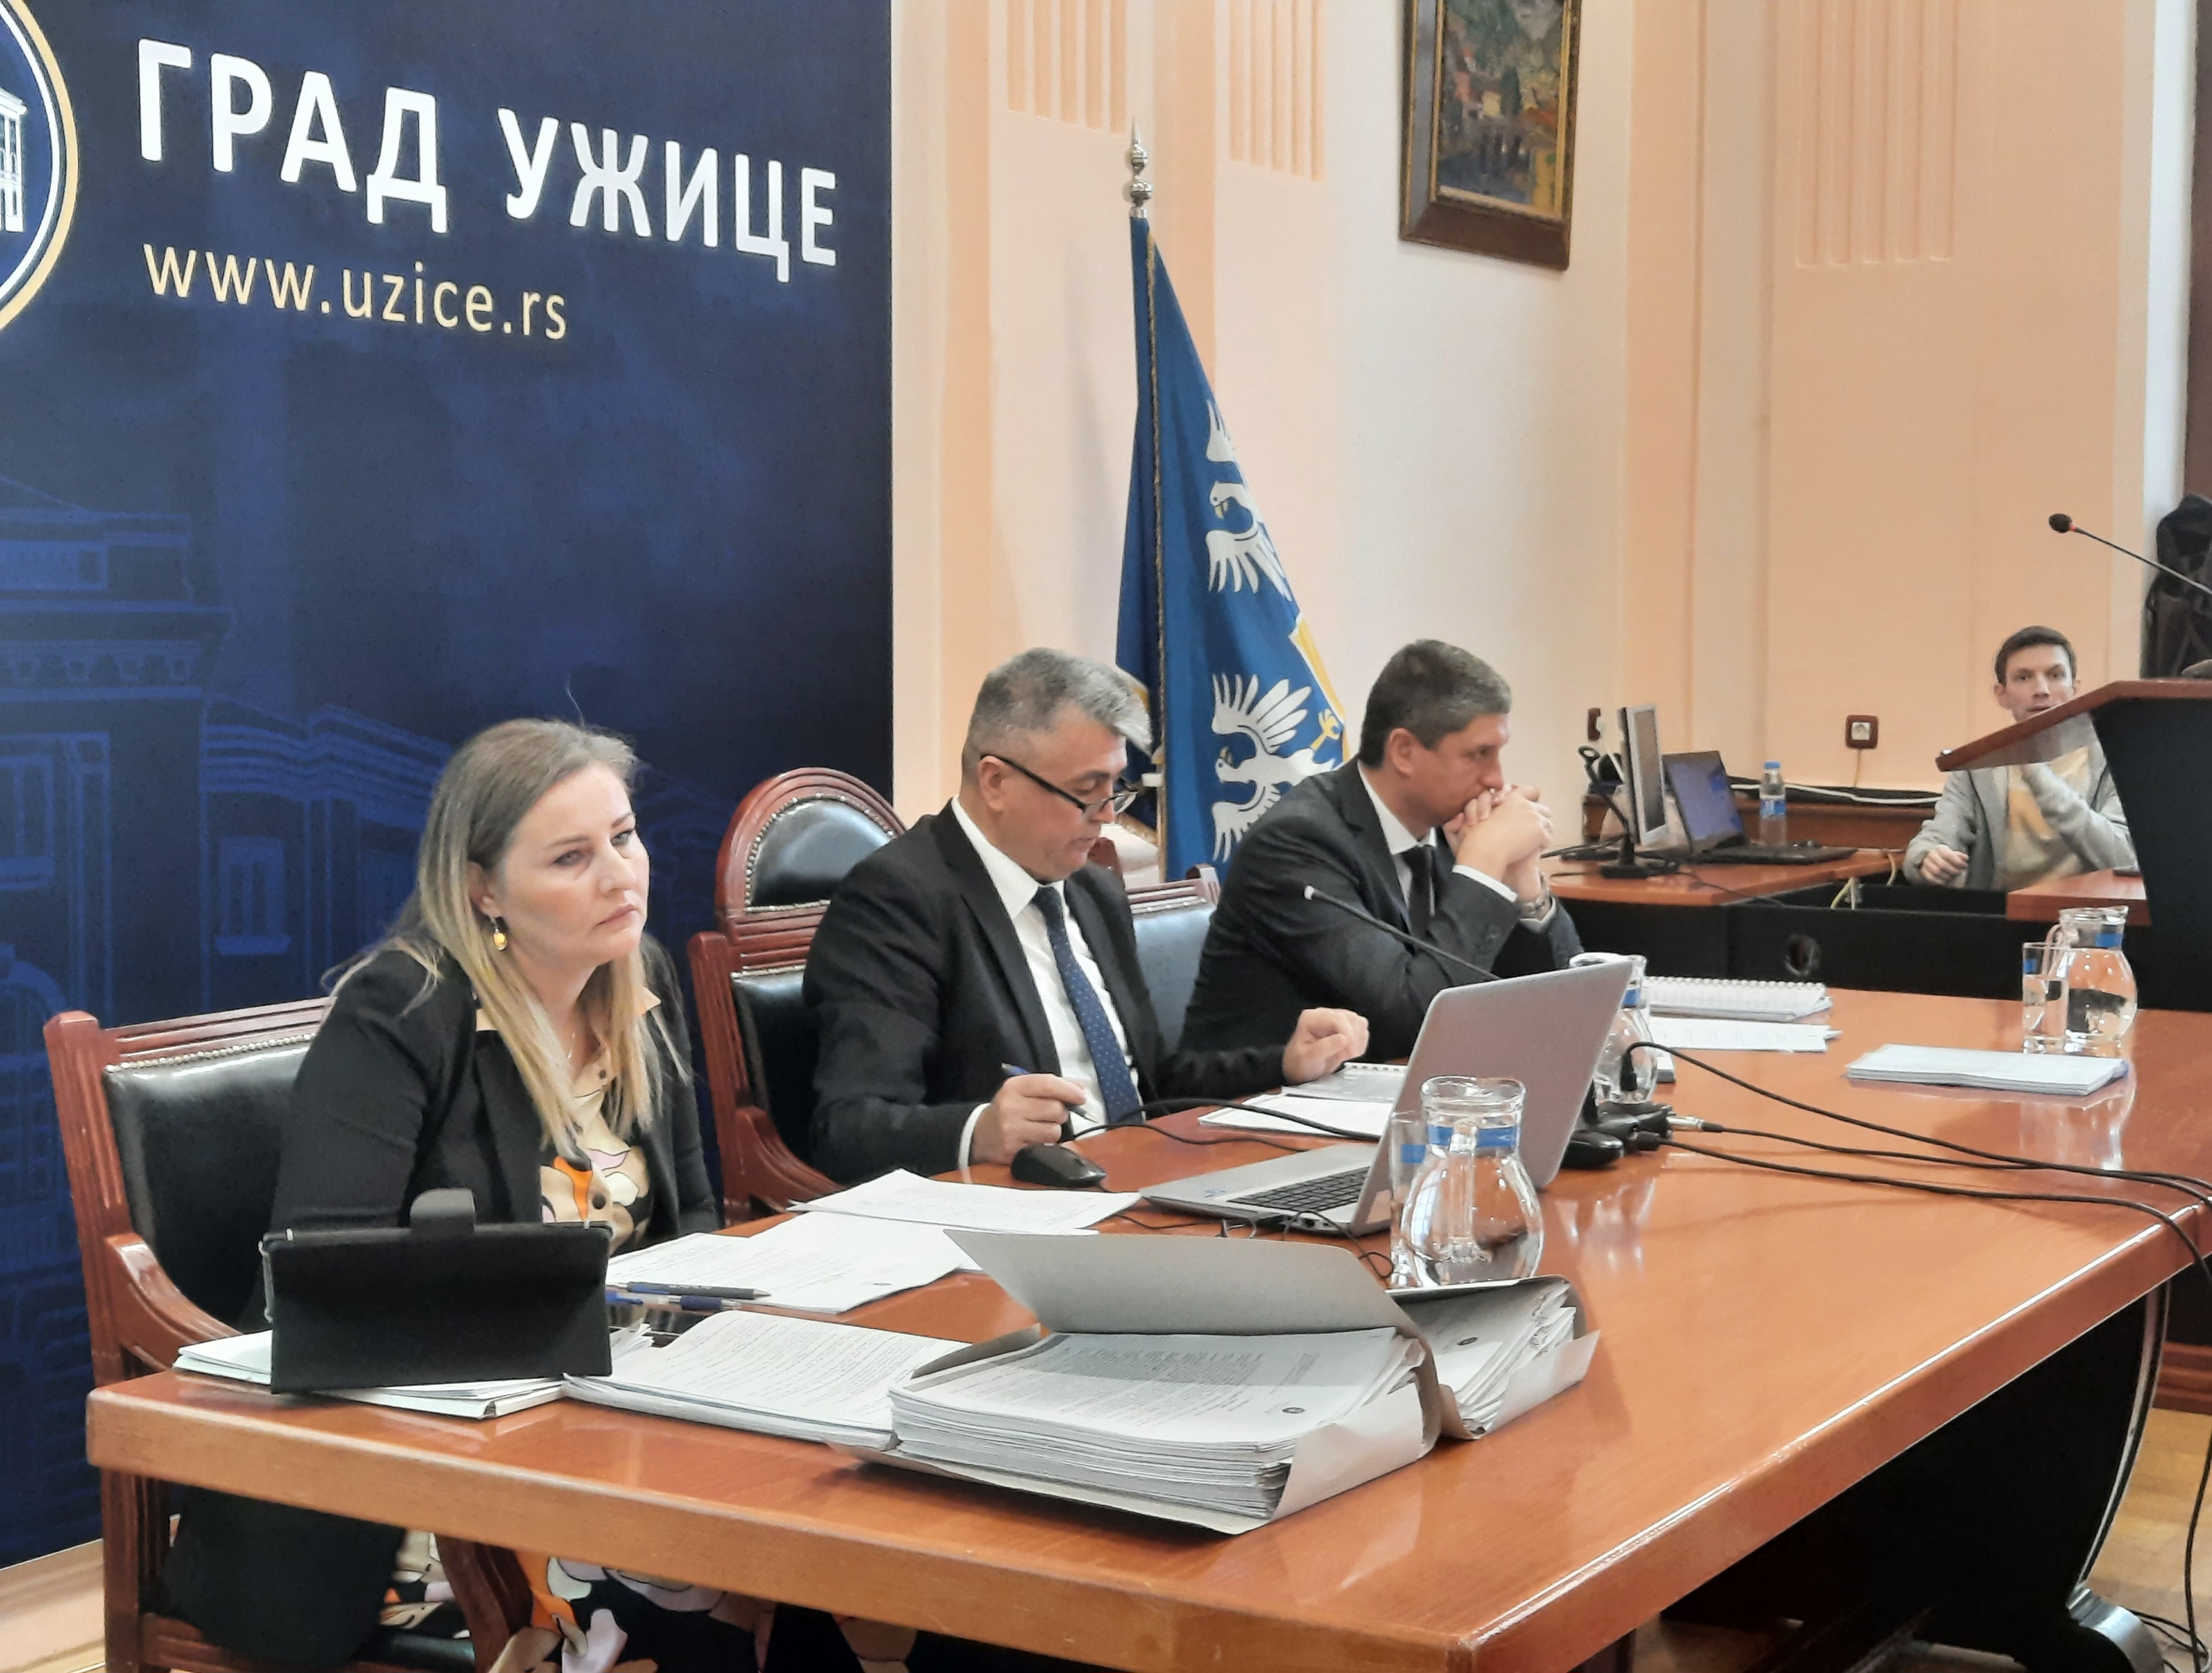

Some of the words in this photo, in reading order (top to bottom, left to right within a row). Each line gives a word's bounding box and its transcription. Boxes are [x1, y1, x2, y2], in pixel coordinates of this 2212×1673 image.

[138, 39, 448, 233] ГРАД
[498, 108, 836, 283] УЖИЦЕ
[143, 243, 567, 340] www.uzice.rs
